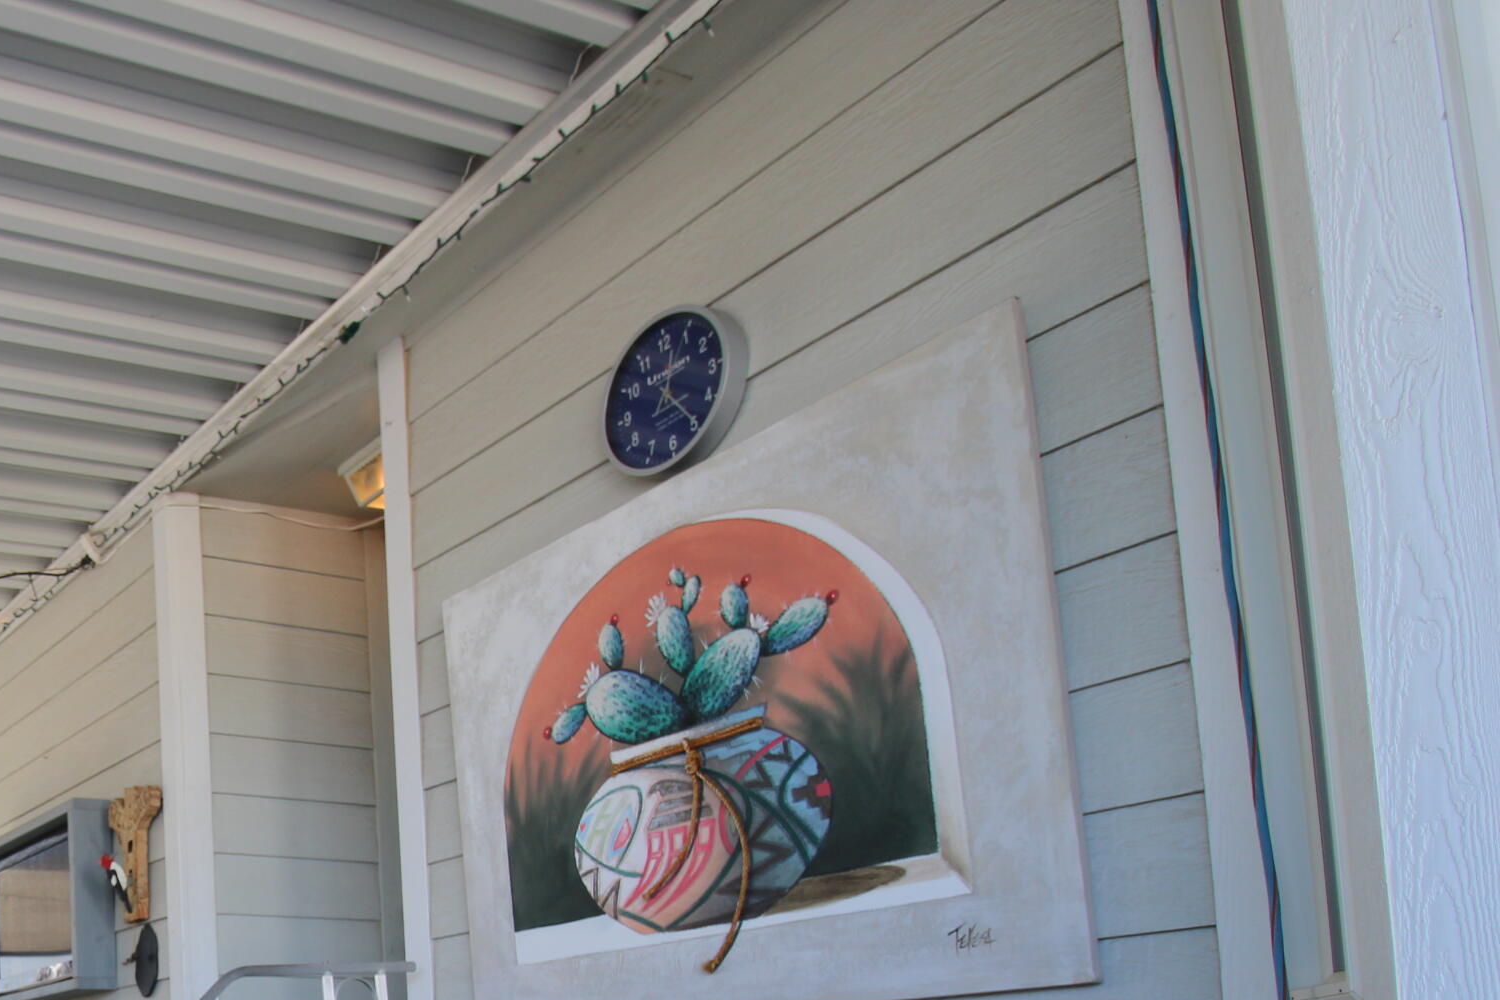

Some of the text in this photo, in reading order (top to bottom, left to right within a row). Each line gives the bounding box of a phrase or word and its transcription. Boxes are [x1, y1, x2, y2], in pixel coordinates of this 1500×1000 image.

[657, 333, 671, 353] 12
[683, 330, 689, 345] 1
[699, 336, 708, 353] 2
[639, 355, 651, 373] 11
[708, 358, 717, 375] 3
[627, 382, 640, 400] 10
[704, 386, 712, 402] 4
[623, 411, 632, 427] 9
[690, 415, 698, 431] 5
[631, 432, 640, 447] 8
[648, 439, 656, 456] 7
[668, 434, 677, 450] 6
